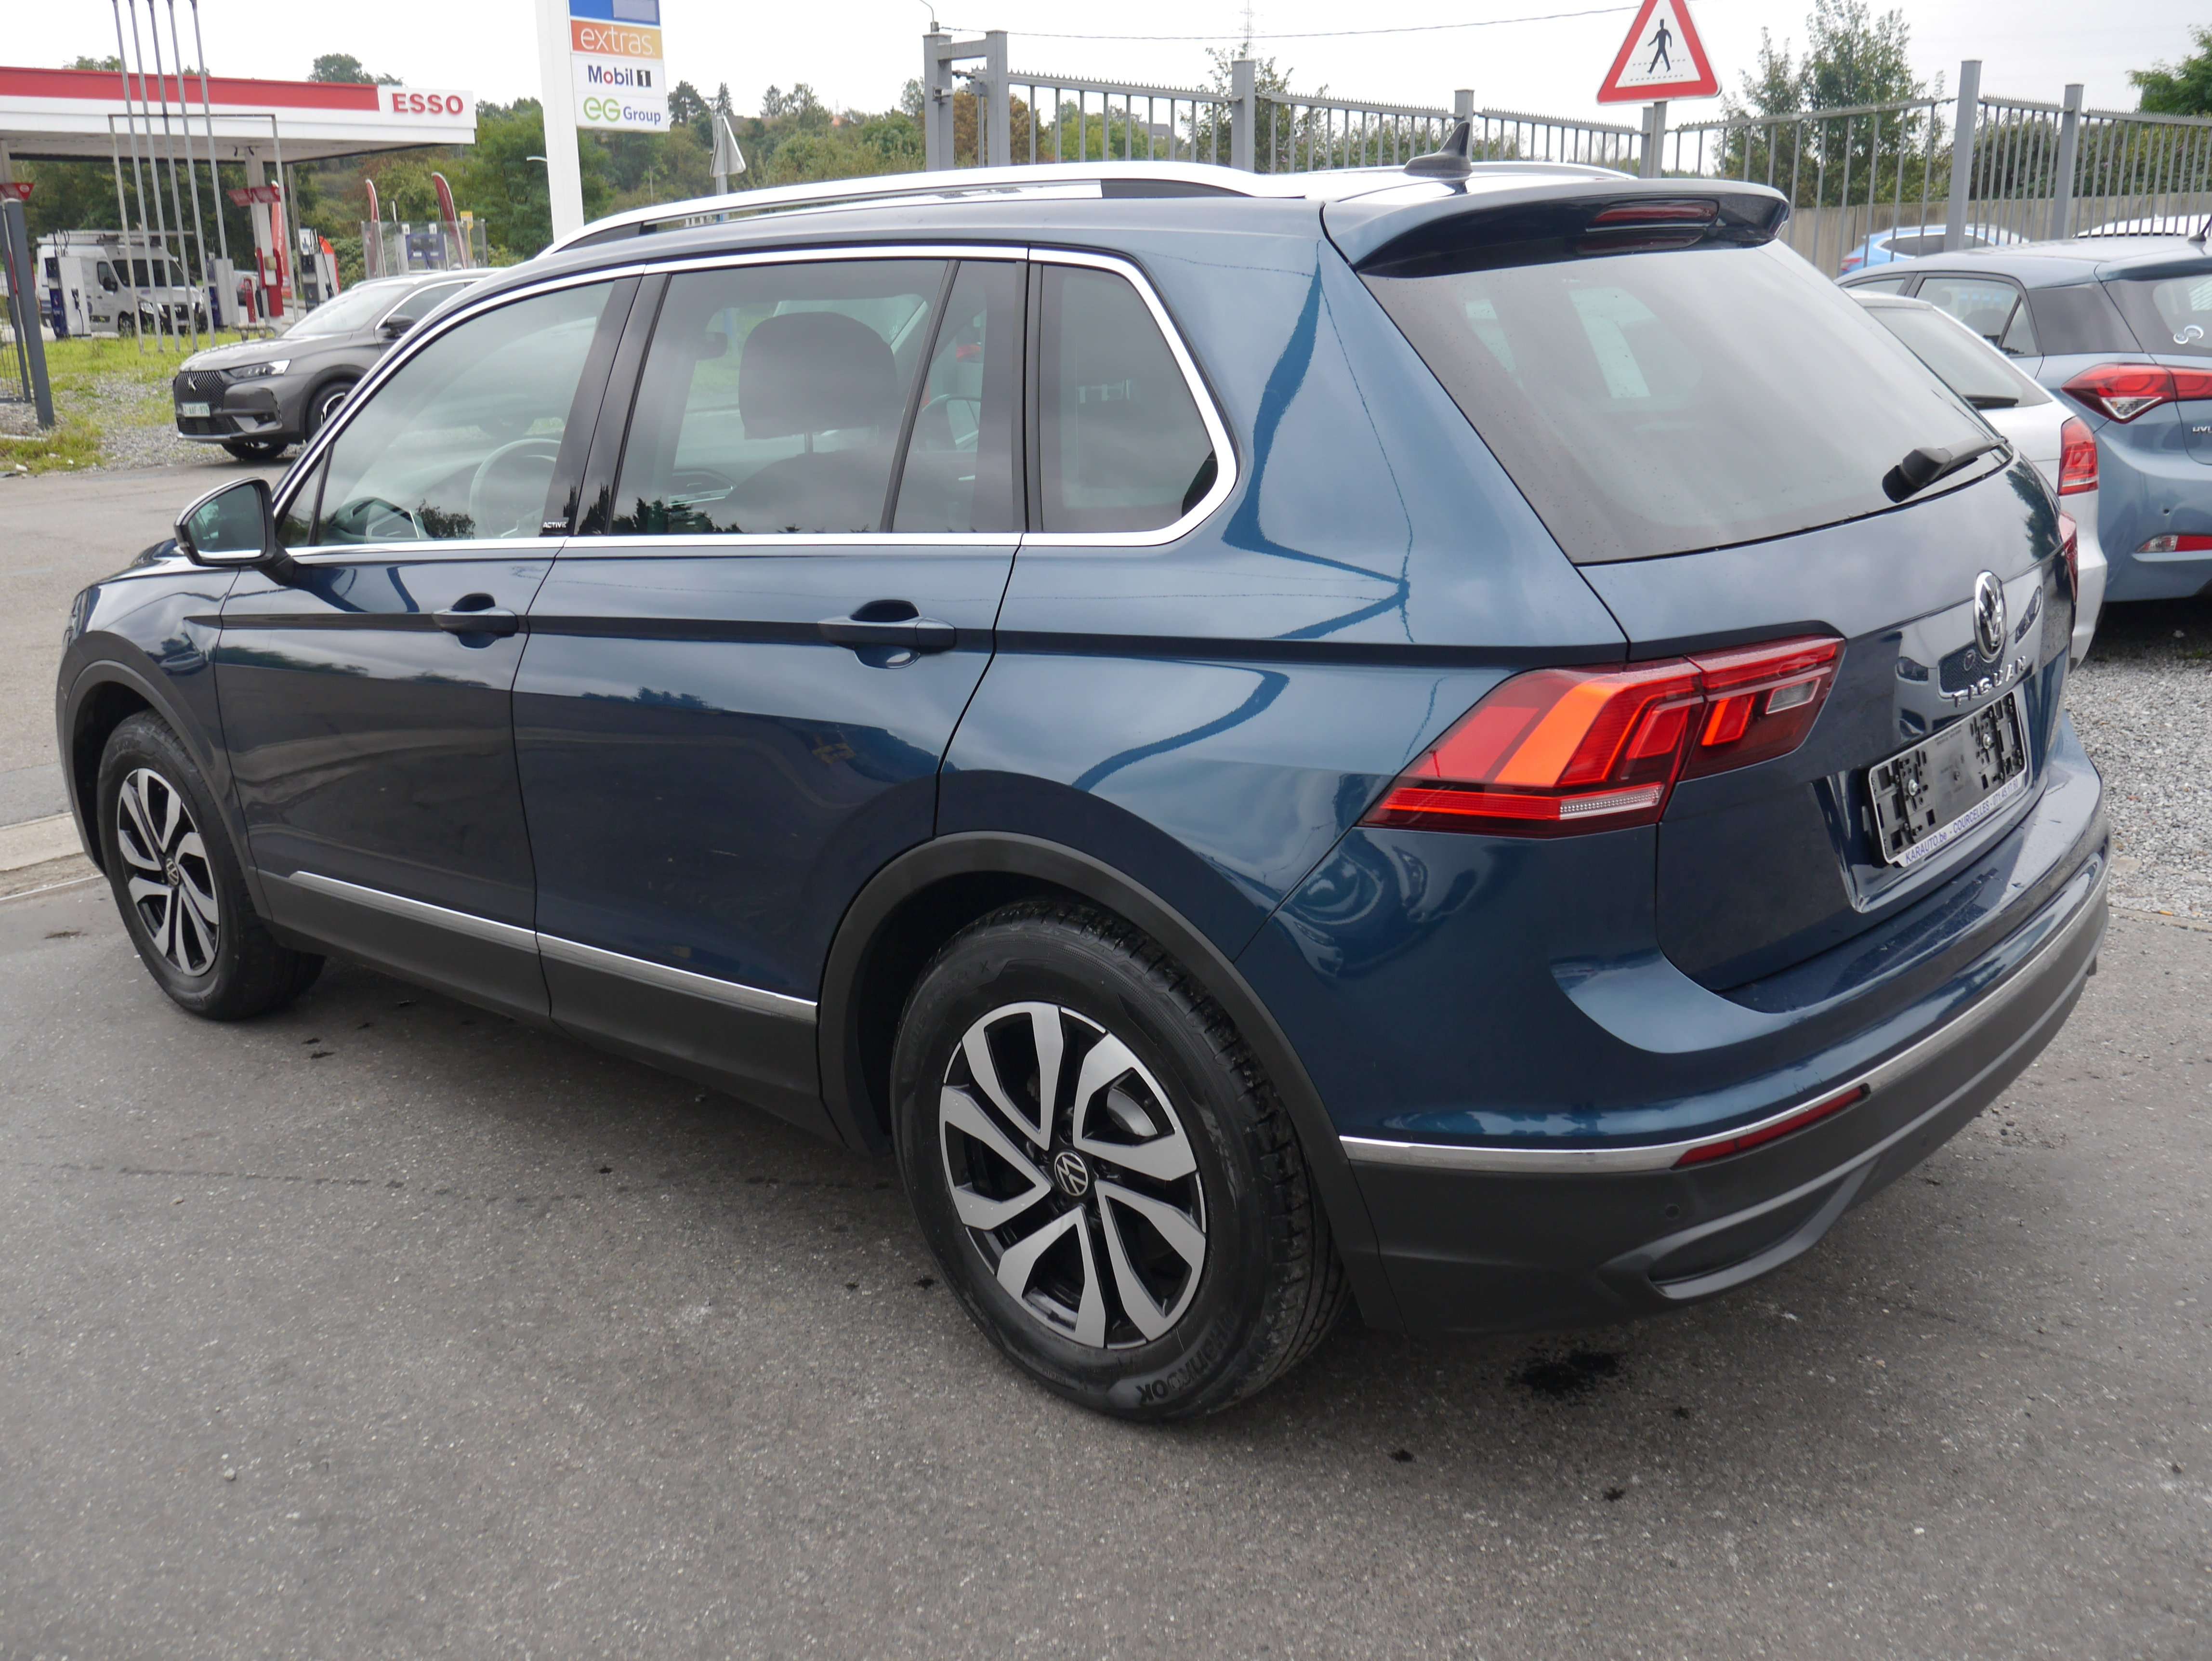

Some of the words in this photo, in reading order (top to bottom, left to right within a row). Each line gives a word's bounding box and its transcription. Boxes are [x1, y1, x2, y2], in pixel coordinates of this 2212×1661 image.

[588, 65, 633, 86] Mobil
[392, 93, 463, 115] ESSO
[623, 106, 661, 125] Group
[1952, 656, 2026, 708] TIGUAN
[1905, 832, 1947, 864] KARAUTO.be
[1953, 800, 1989, 833] COURCELLES
